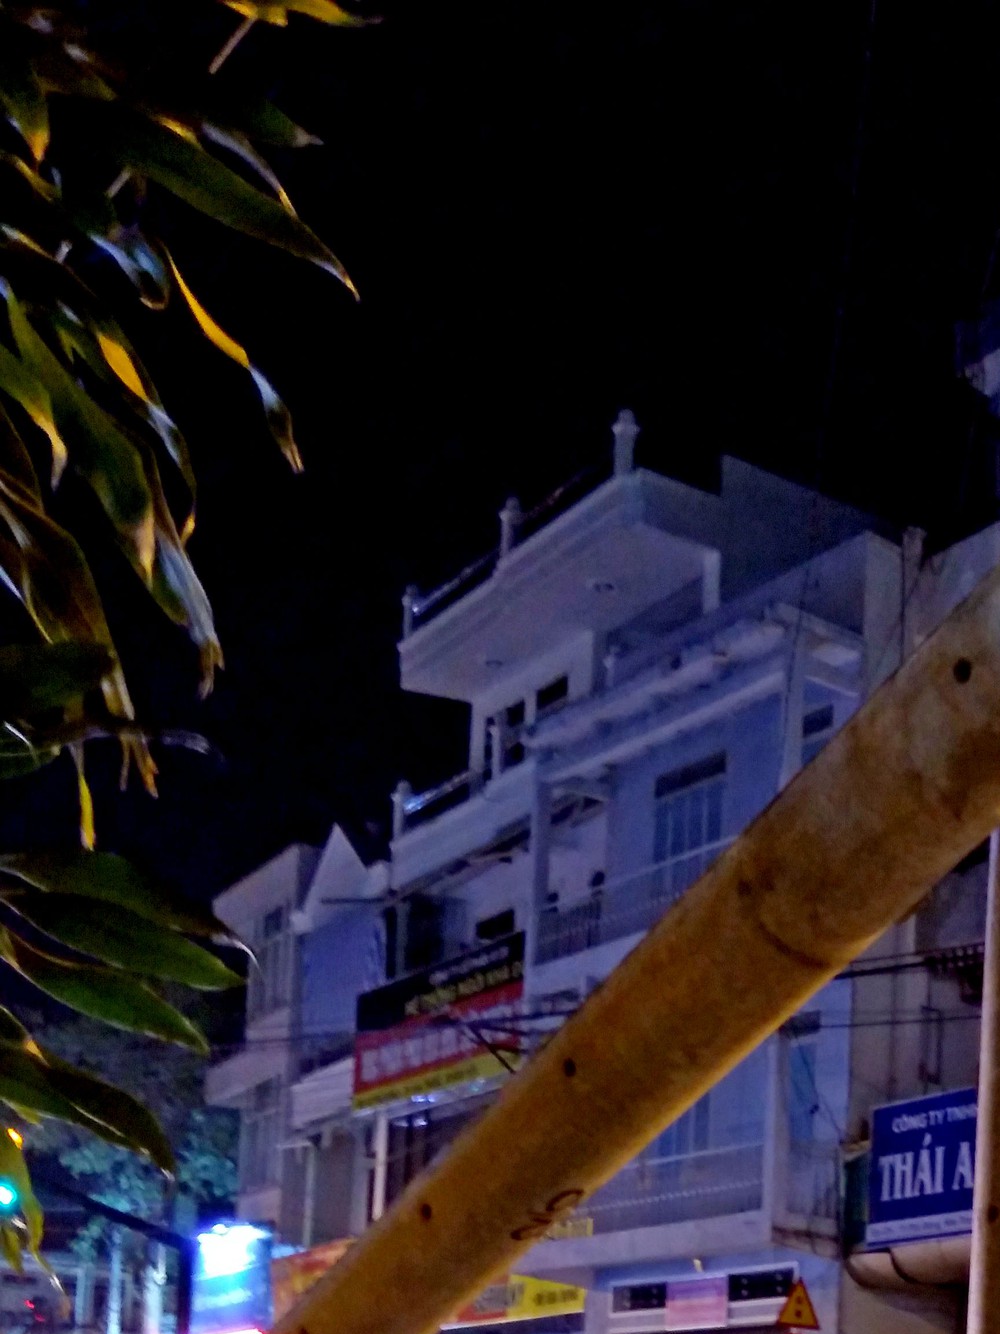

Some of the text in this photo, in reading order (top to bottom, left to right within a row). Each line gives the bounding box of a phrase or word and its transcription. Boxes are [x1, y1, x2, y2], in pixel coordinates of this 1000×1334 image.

[892, 1112, 928, 1134] CÔNG
[928, 1109, 945, 1126] TY
[878, 1132, 946, 1201] THÁI
